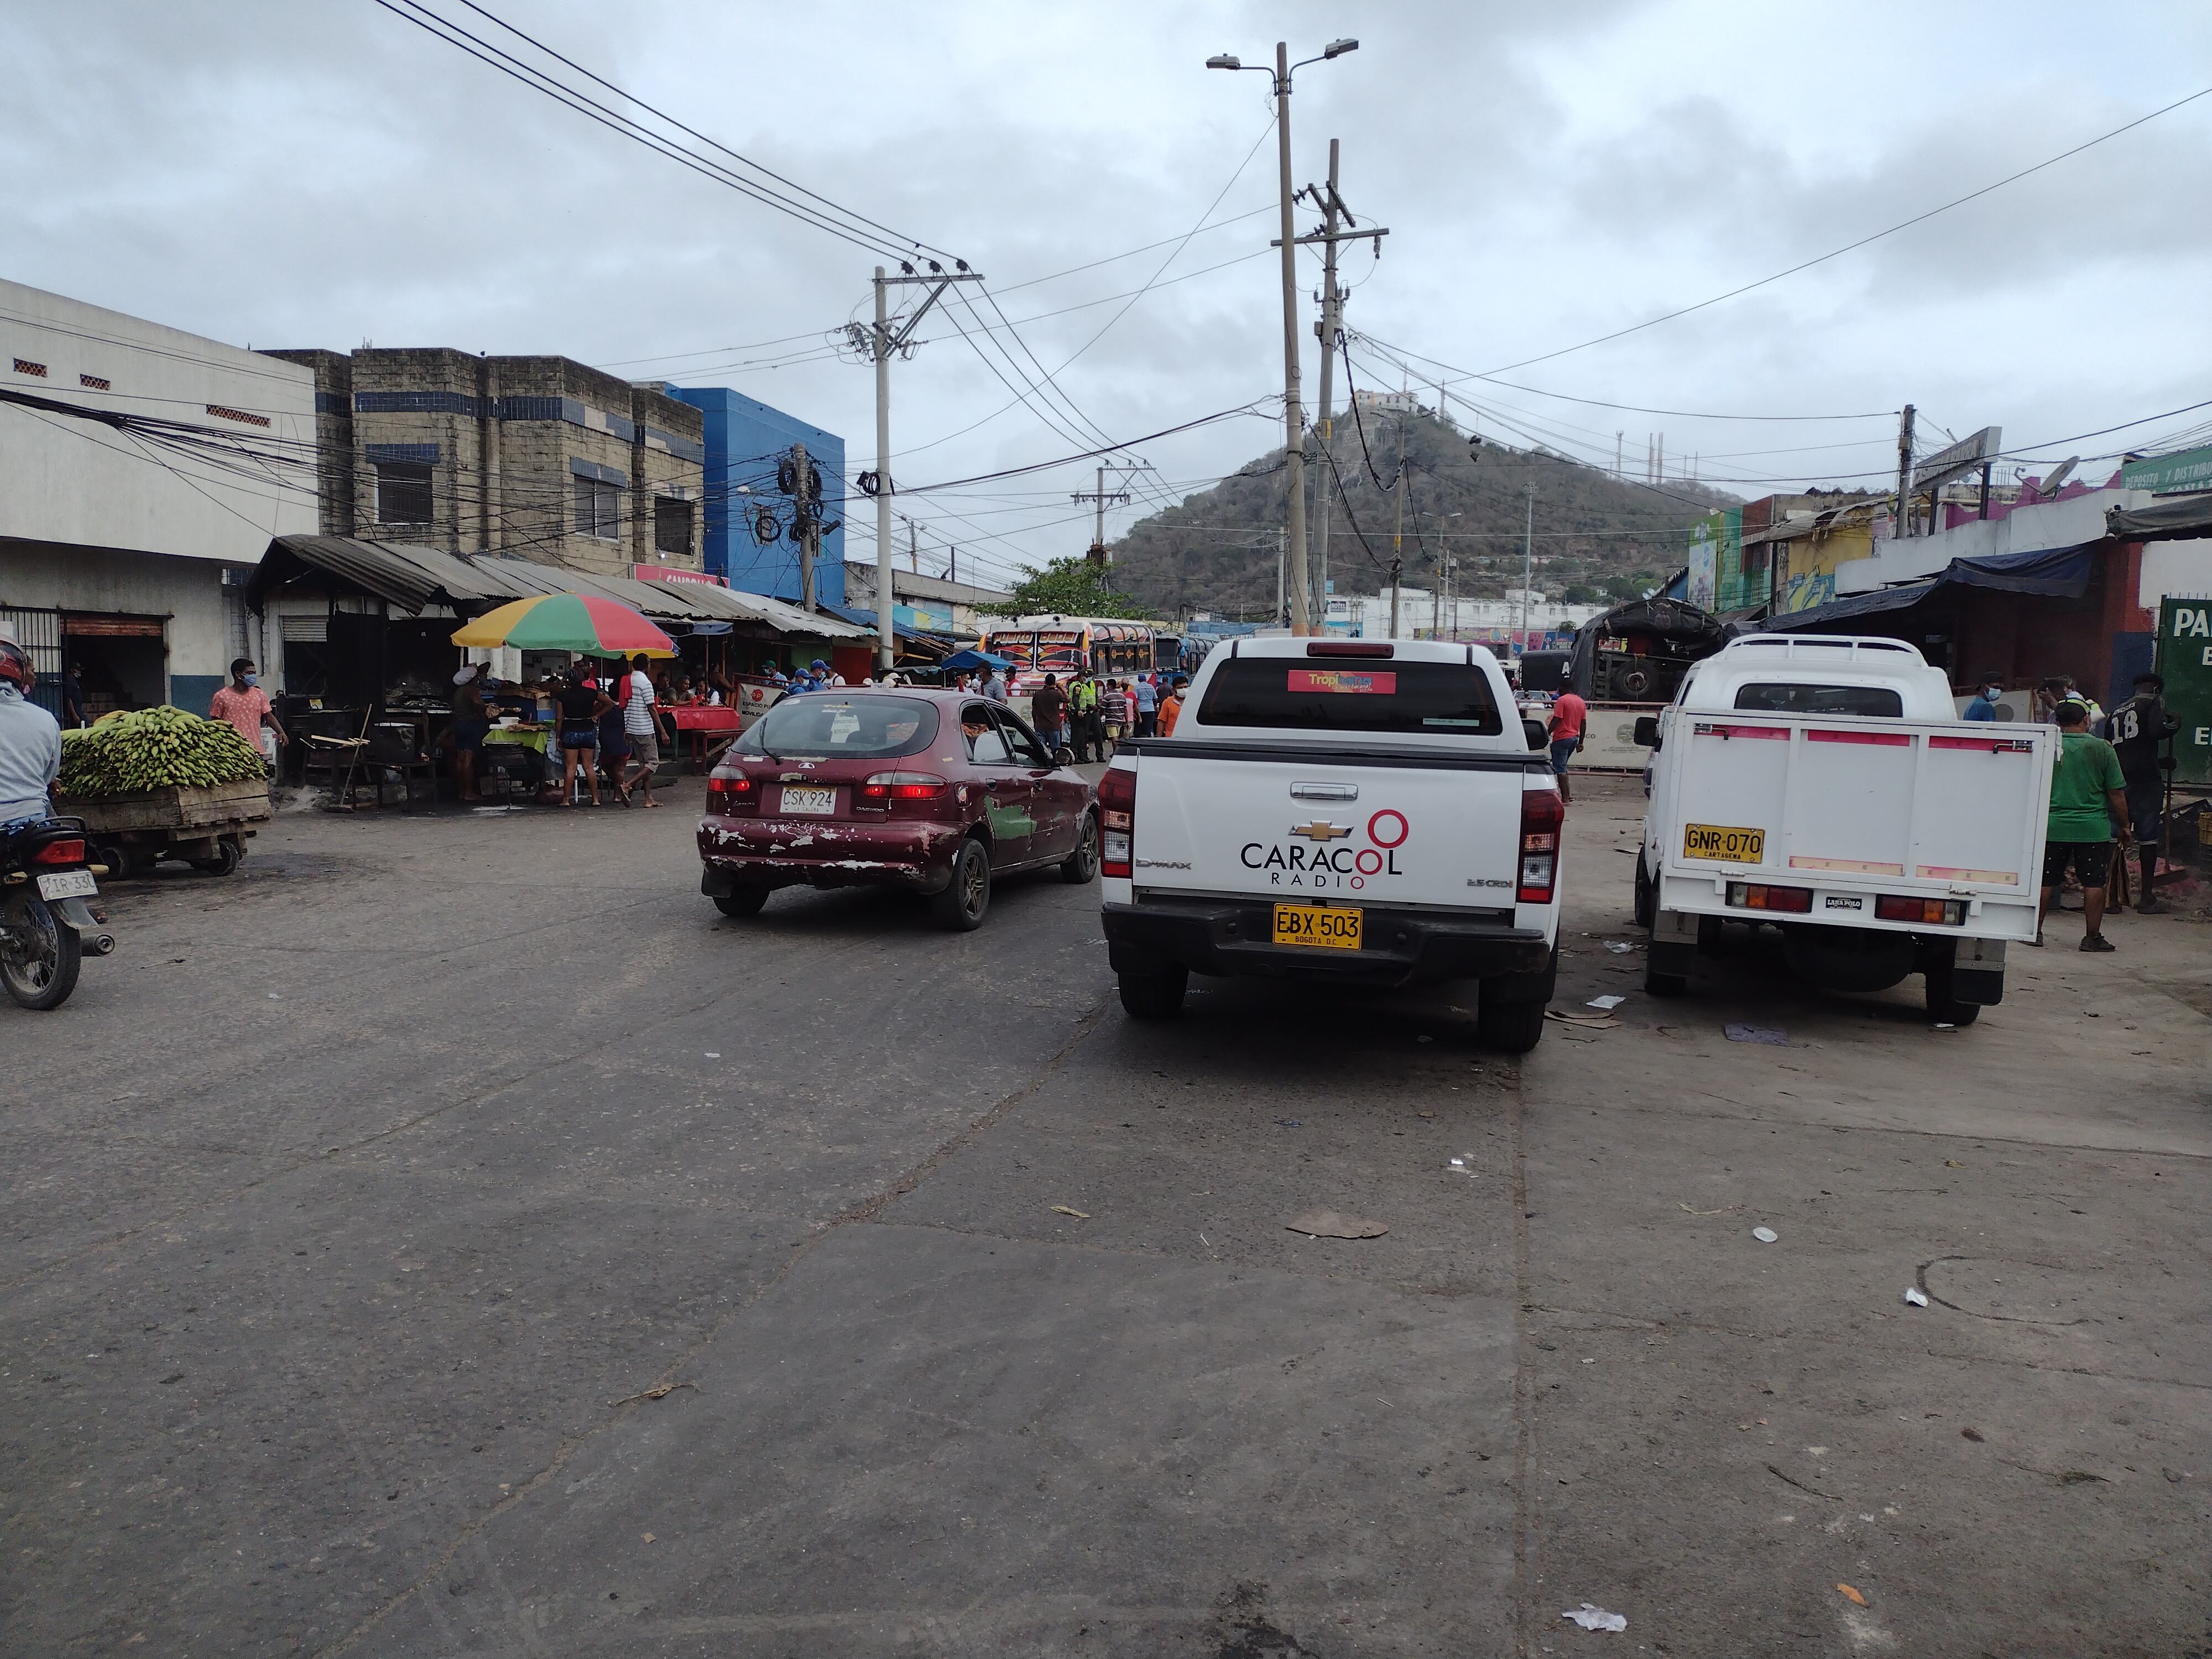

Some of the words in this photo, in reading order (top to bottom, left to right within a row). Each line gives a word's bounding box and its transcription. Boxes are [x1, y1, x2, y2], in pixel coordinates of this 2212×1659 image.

[2125, 473, 2159, 489] DEPOSITO
[2165, 469, 2172, 483] Y
[2174, 609, 2212, 637] PA
[2111, 709, 2139, 746] 18
[784, 791, 806, 806] CSK
[810, 791, 832, 806] 924
[1688, 830, 1721, 851] GNR
[1726, 833, 1761, 853] 070
[1240, 843, 1402, 875] CARACOL
[1271, 872, 1364, 889] RADIO
[1277, 911, 1314, 935] EBX
[1320, 914, 1359, 938] 503
[1295, 936, 1321, 944] BOGOTA
